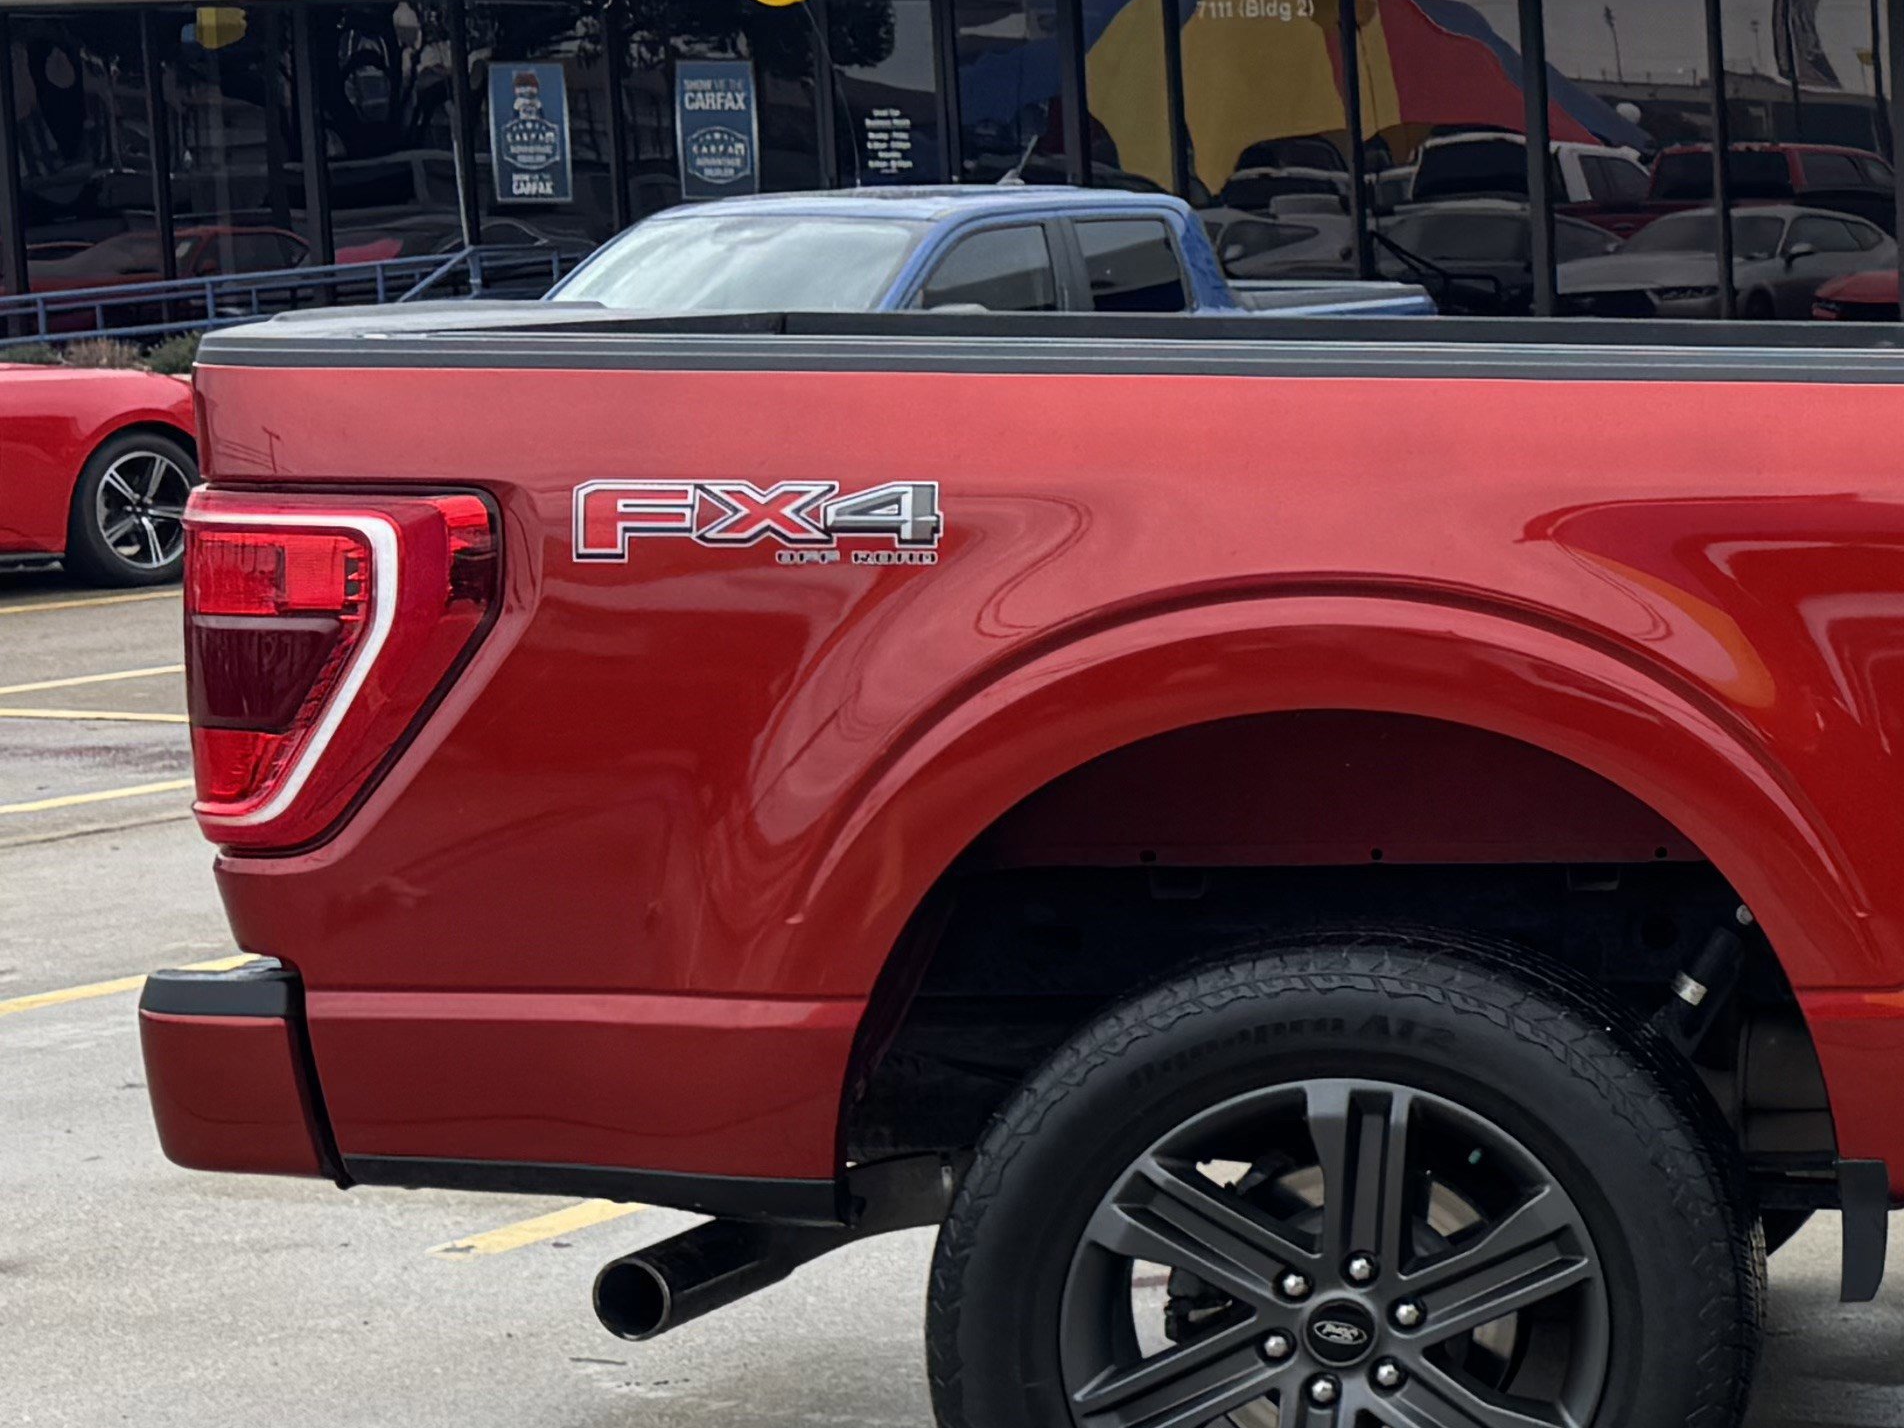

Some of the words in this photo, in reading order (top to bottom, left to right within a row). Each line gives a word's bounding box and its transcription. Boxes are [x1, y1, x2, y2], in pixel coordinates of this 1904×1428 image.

[1197, 0, 1233, 19] 7111
[684, 92, 747, 111] CARFAX
[573, 479, 943, 564] FX4
[775, 549, 841, 566] OFF
